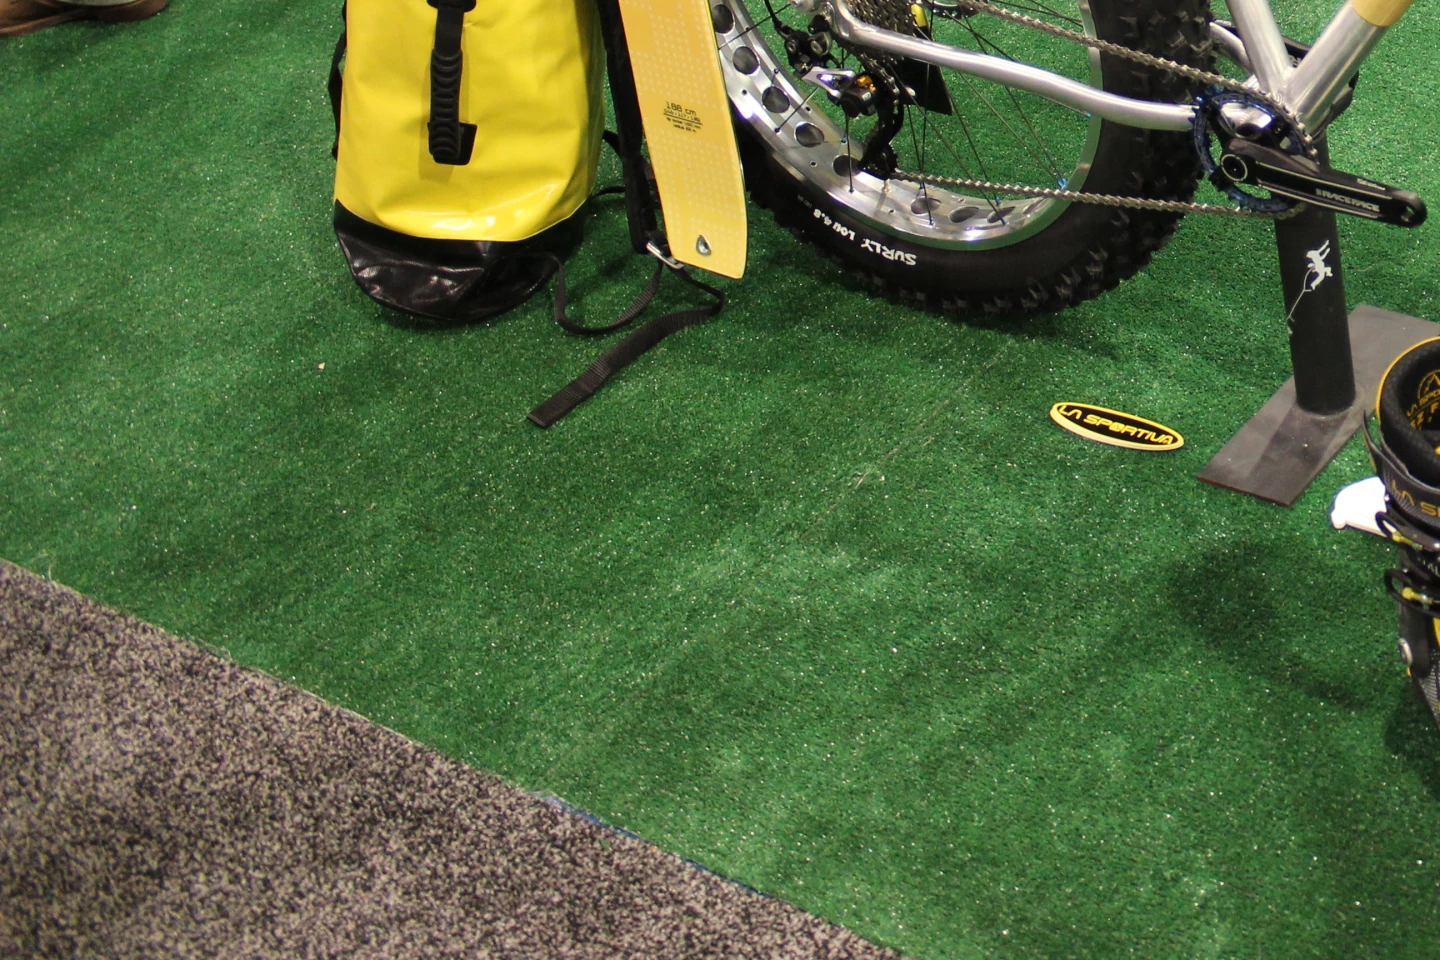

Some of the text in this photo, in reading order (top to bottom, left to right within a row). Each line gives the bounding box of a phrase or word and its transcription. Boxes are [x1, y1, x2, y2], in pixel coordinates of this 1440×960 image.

[832, 220, 857, 242] LOU
[860, 237, 918, 267] SURLY
[1059, 404, 1174, 446] LA SPORTIVA
[1391, 479, 1415, 507] LA
